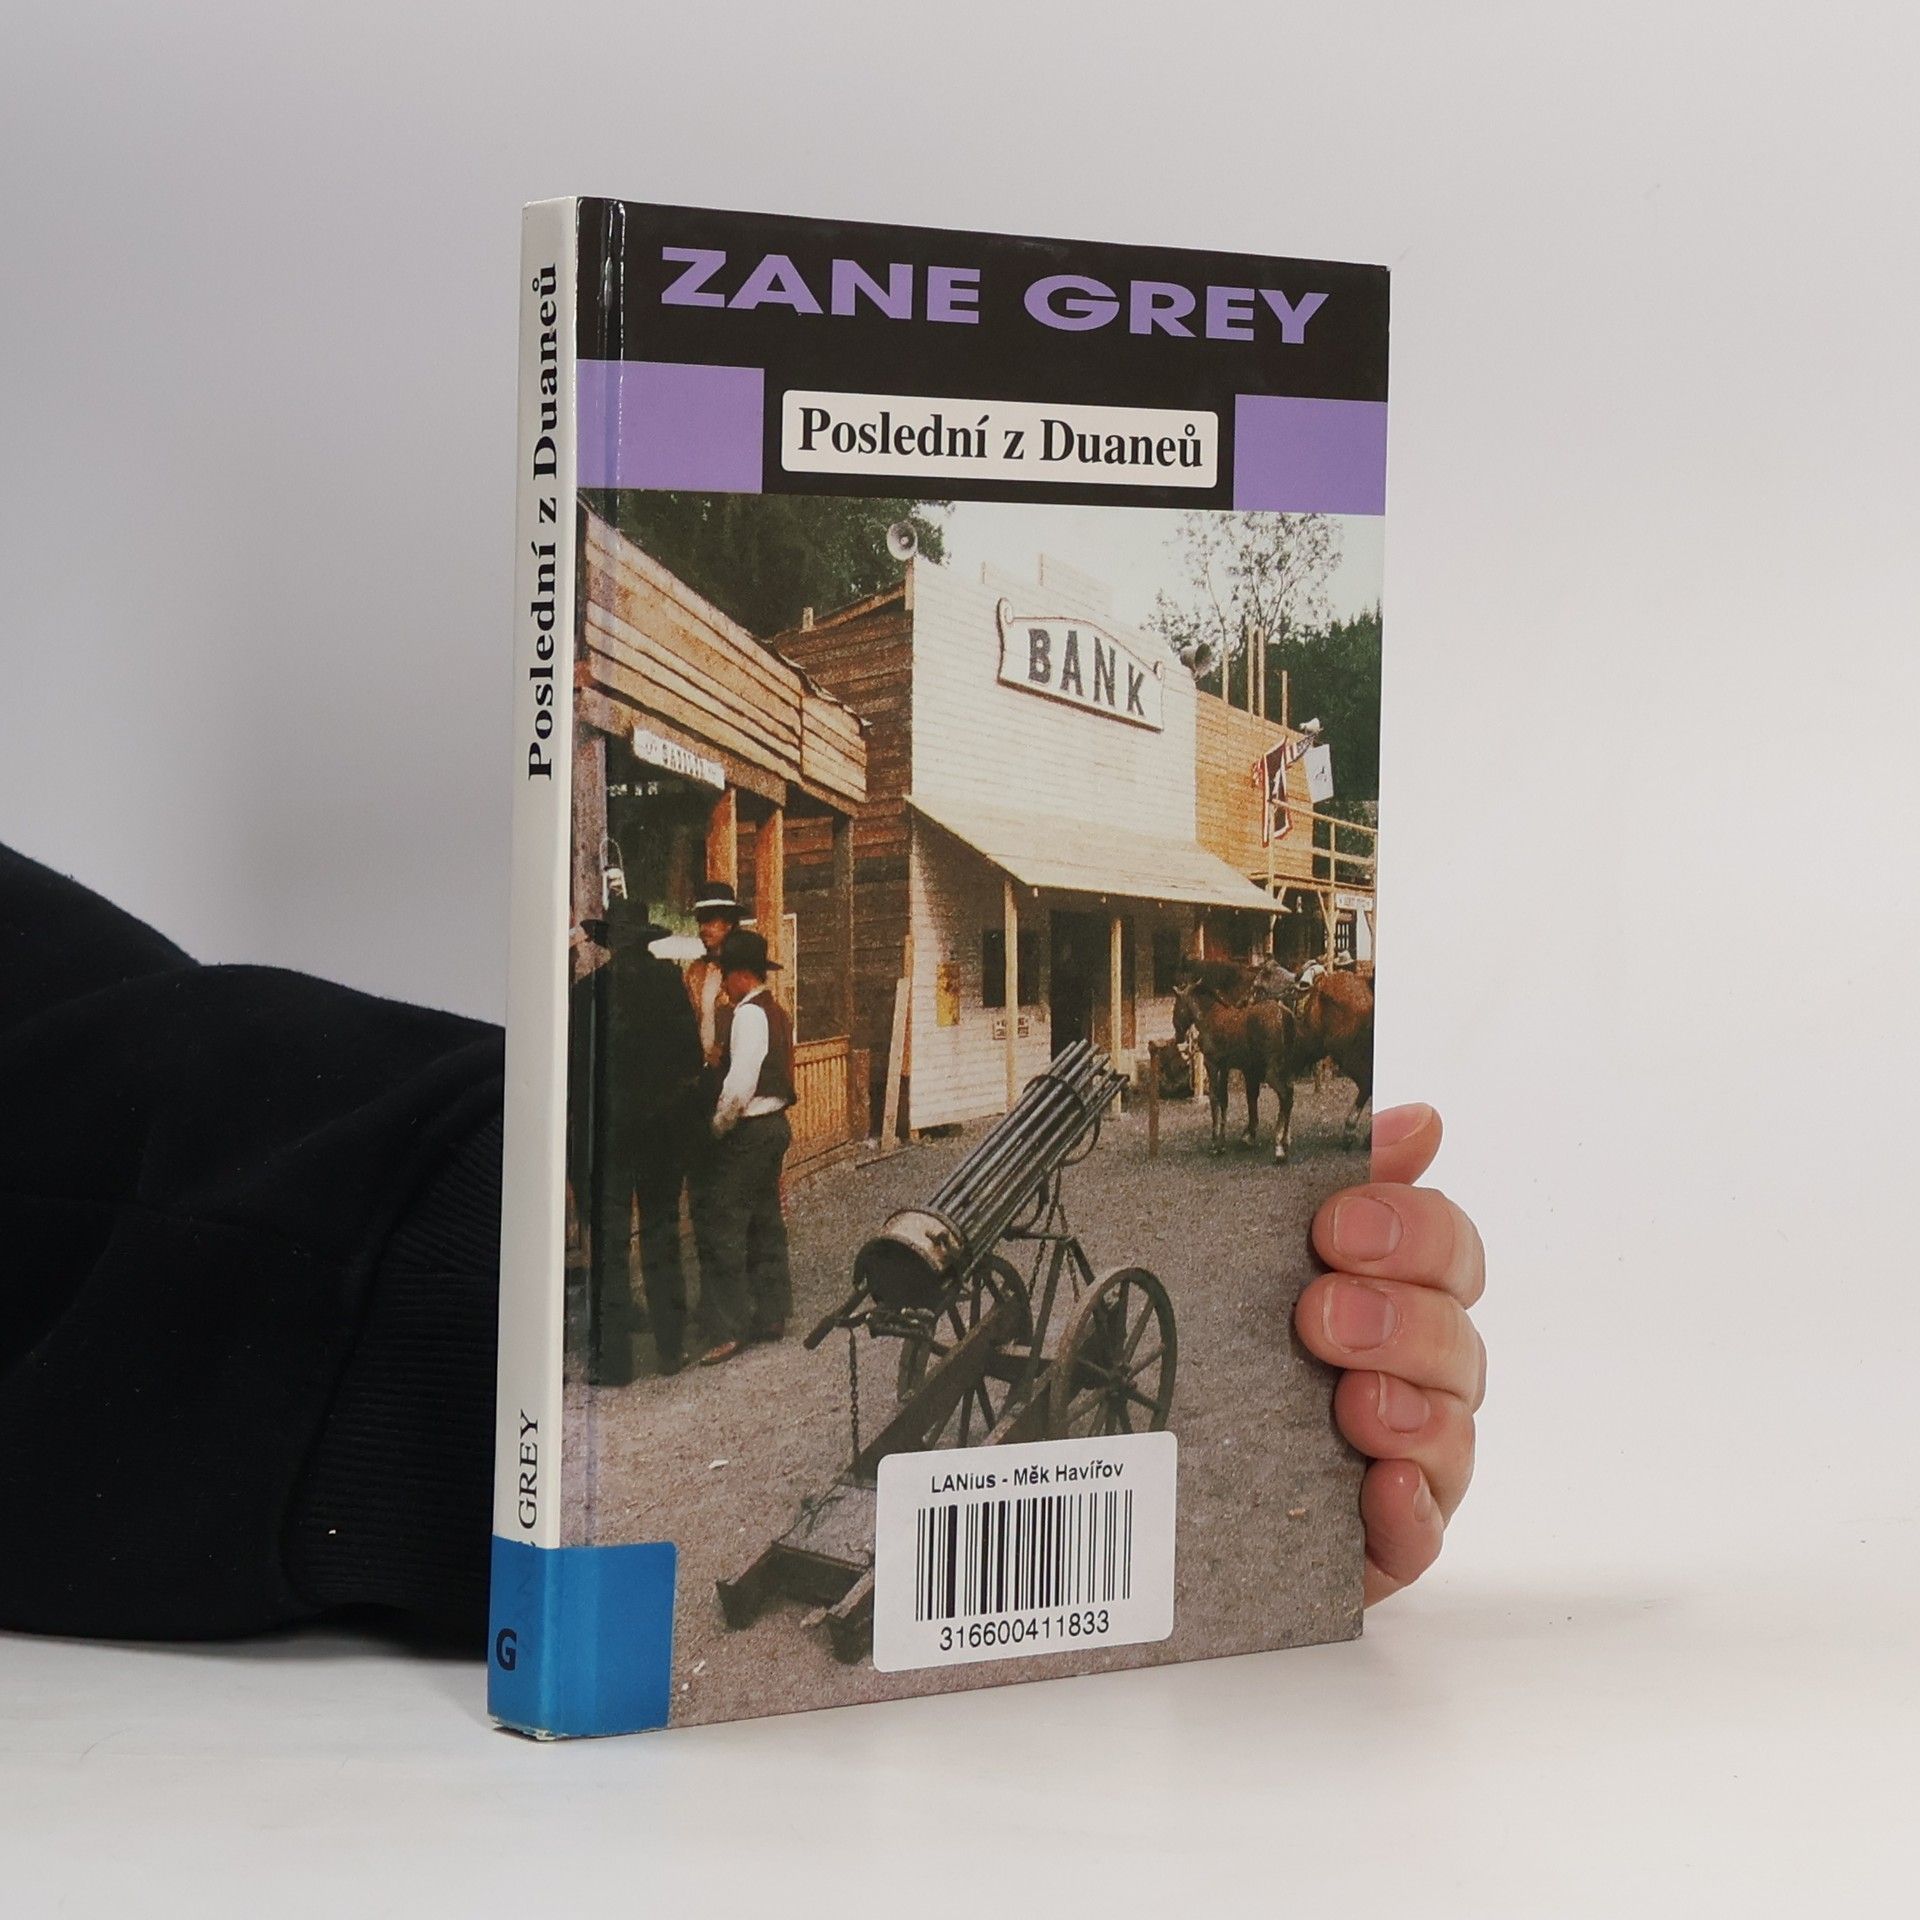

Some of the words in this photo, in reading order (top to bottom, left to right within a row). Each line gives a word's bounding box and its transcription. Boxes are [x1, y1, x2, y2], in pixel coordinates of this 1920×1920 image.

[661, 246, 981, 325] ZANE
[1023, 273, 1330, 345] GREY
[532, 262, 558, 481] Duaneů
[798, 406, 989, 460] Poslední
[1002, 430, 1025, 460] z
[1040, 419, 1203, 468] Duaneů
[538, 497, 557, 524] z
[527, 541, 556, 780] Poslední
[1028, 628, 1145, 716] BANK
[517, 1408, 539, 1530] GREY
[931, 1473, 996, 1494] LANius
[1013, 1464, 1050, 1487] Měk
[1055, 1459, 1124, 1483] Havířov
[495, 1627, 518, 1672] G
[939, 1610, 1110, 1651] 316600411833
